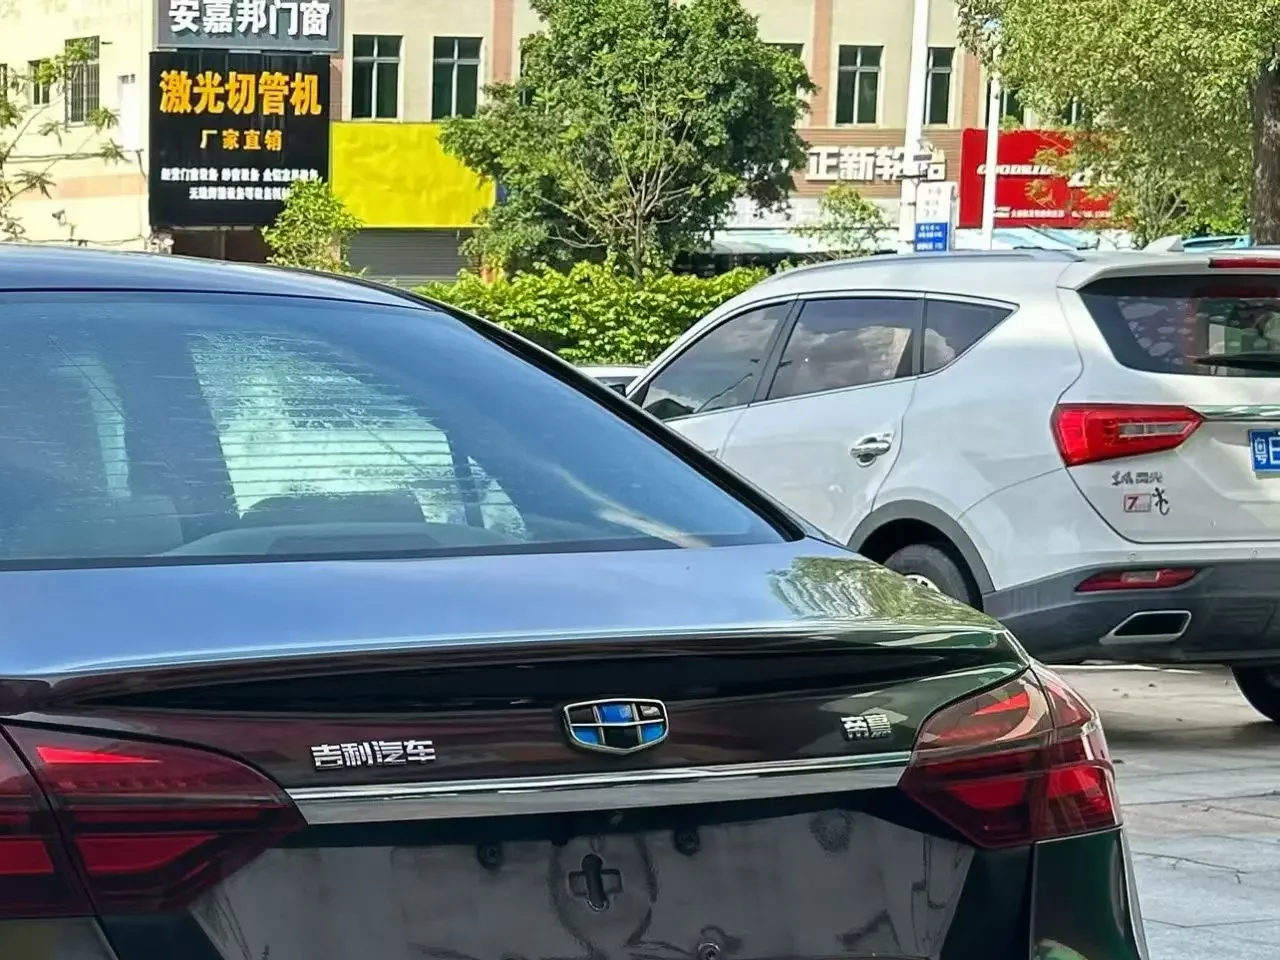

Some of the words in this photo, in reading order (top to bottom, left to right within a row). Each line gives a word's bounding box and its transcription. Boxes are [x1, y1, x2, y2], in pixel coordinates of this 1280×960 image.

[169, 0, 331, 36] 安嘉邦门窗
[159, 70, 322, 116] 激光切管机
[200, 129, 283, 151] 厂家直销
[311, 740, 437, 769] 吉利汽车
